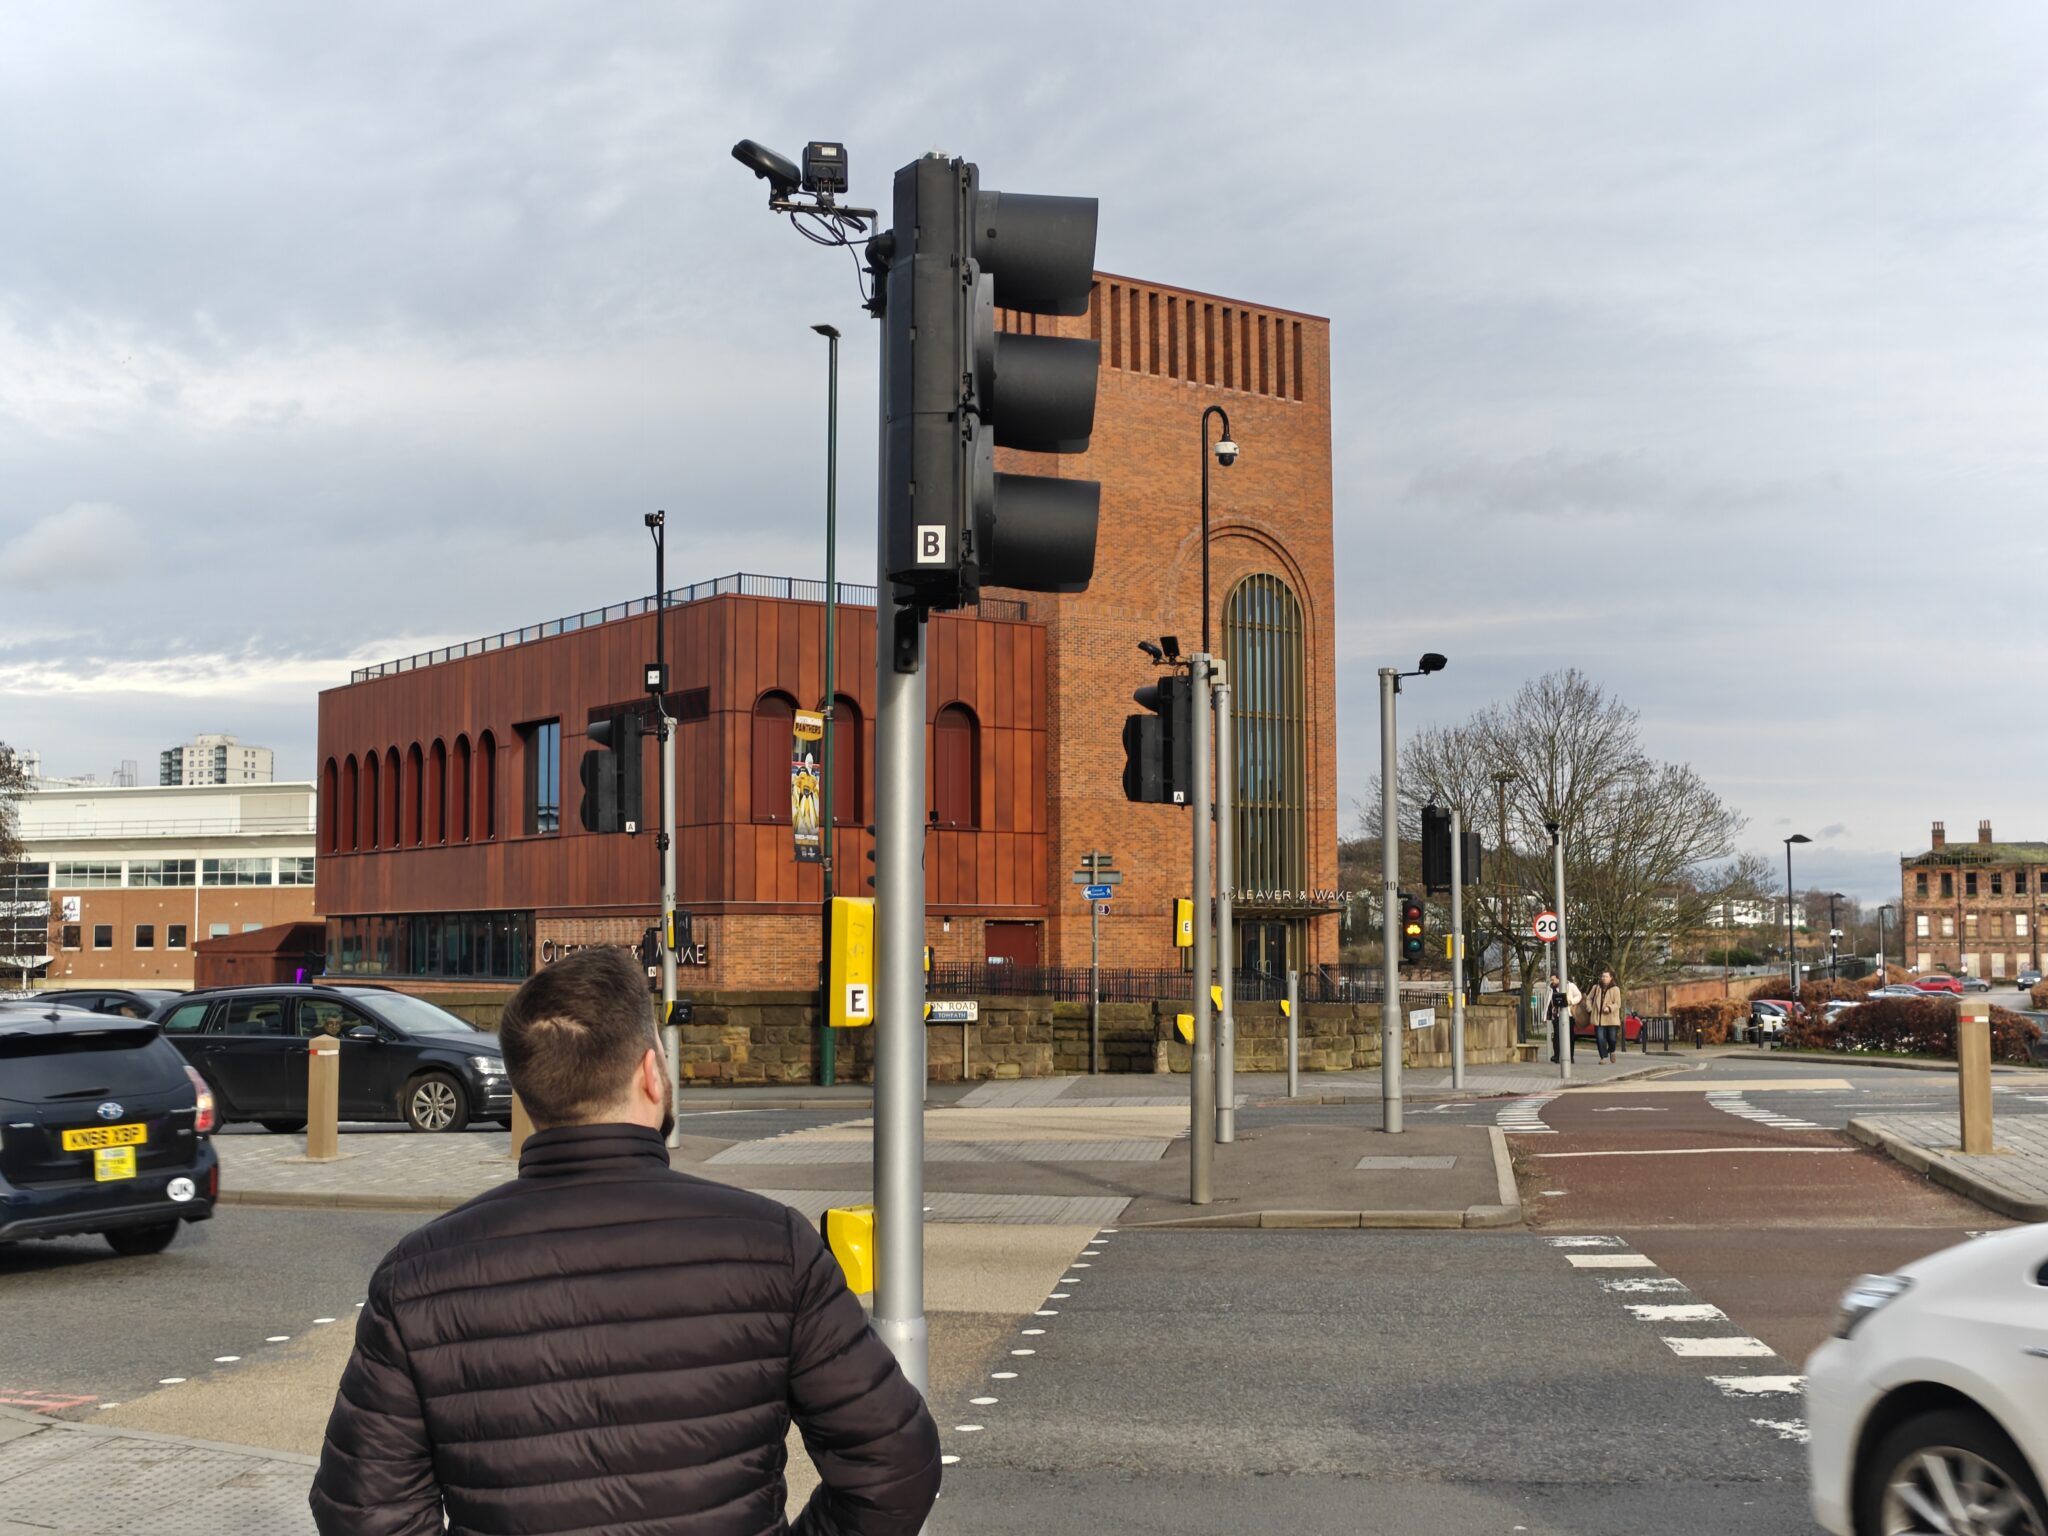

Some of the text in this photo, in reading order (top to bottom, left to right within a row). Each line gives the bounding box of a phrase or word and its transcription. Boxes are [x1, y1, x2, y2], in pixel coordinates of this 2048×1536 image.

[923, 531, 940, 557] B
[1175, 793, 1182, 801] A
[628, 823, 634, 831] A
[1385, 881, 1396, 891] 10
[1299, 890, 1307, 900] &
[1313, 888, 1354, 901] WAKE
[1184, 922, 1190, 932] E
[1538, 920, 1557, 933] 20
[851, 990, 865, 1012] E
[949, 1002, 977, 1010] ROAD
[169, 1182, 194, 1197] UK
